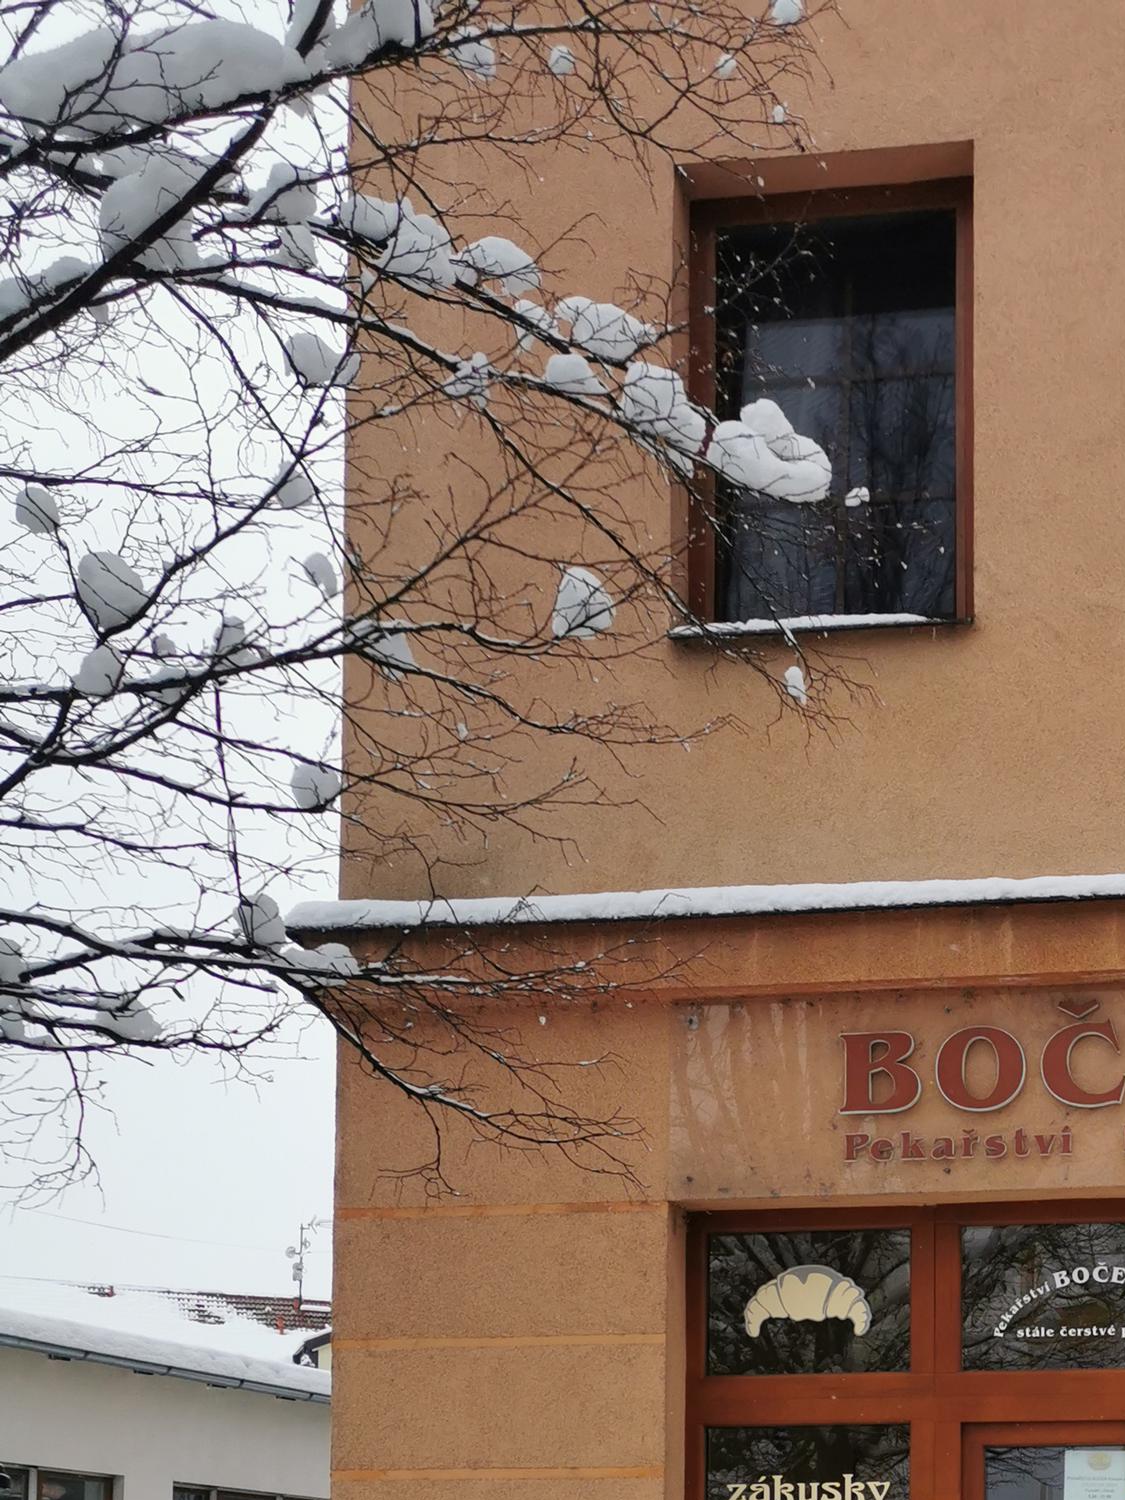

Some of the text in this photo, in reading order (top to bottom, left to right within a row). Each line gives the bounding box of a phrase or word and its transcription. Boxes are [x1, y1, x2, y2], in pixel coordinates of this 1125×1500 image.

[844, 1126, 1073, 1163] Pekařství
[993, 1280, 1051, 1338] Pekařství
[1016, 1326, 1055, 1338] stále
[1060, 1325, 1116, 1337] čerstvé
